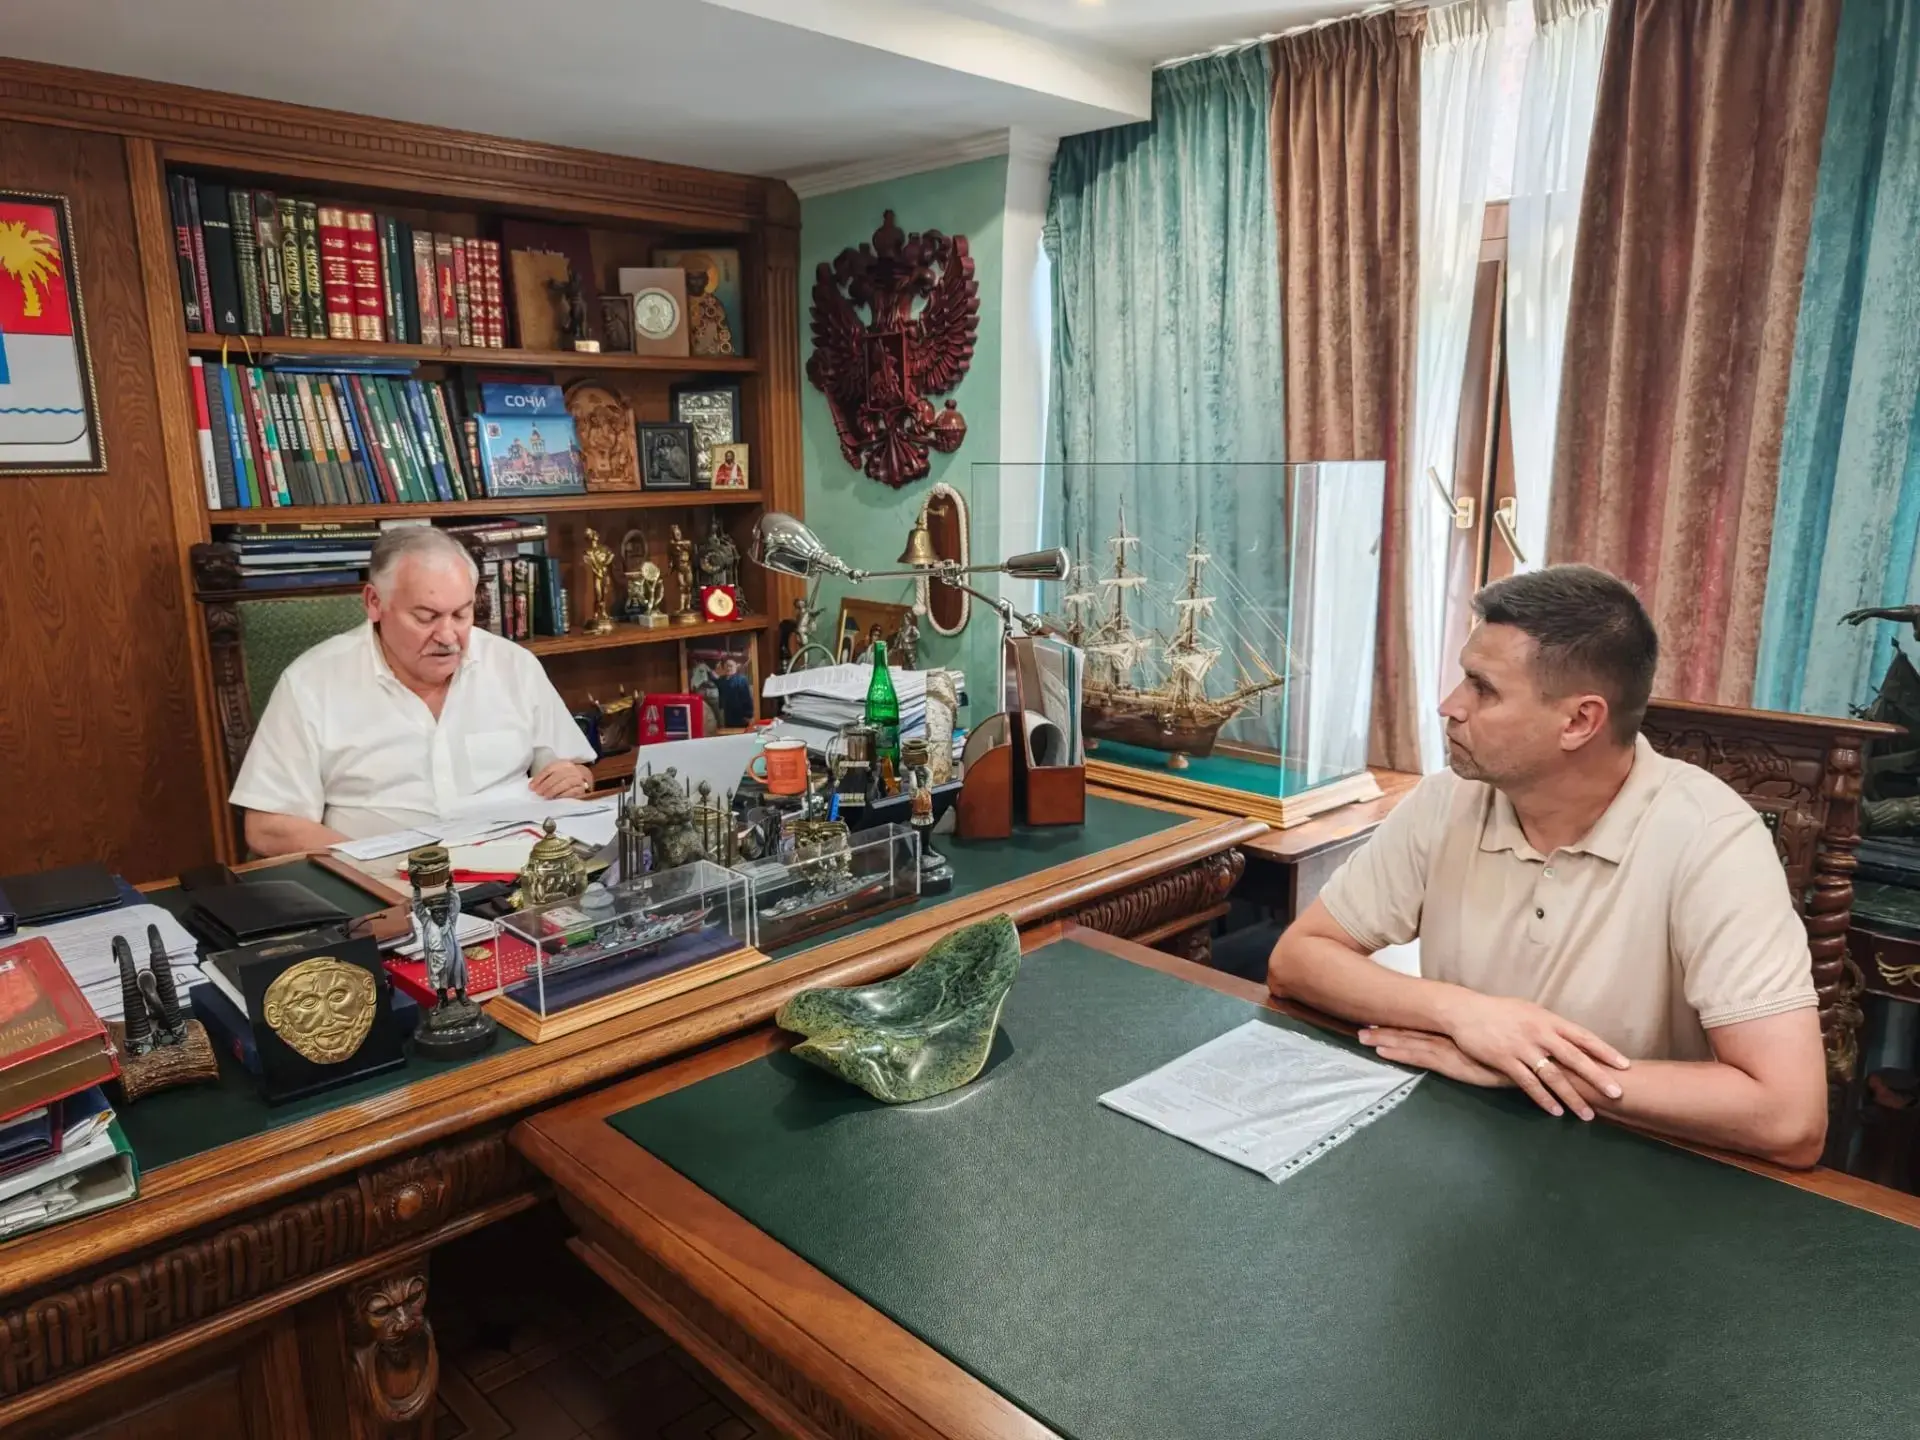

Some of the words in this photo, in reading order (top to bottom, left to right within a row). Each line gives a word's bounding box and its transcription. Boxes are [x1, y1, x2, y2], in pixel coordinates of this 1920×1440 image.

[285, 246, 300, 292] АБХАЗИЯ
[306, 249, 320, 294] АБХАЗИЯ
[504, 395, 546, 407] СОЧИ
